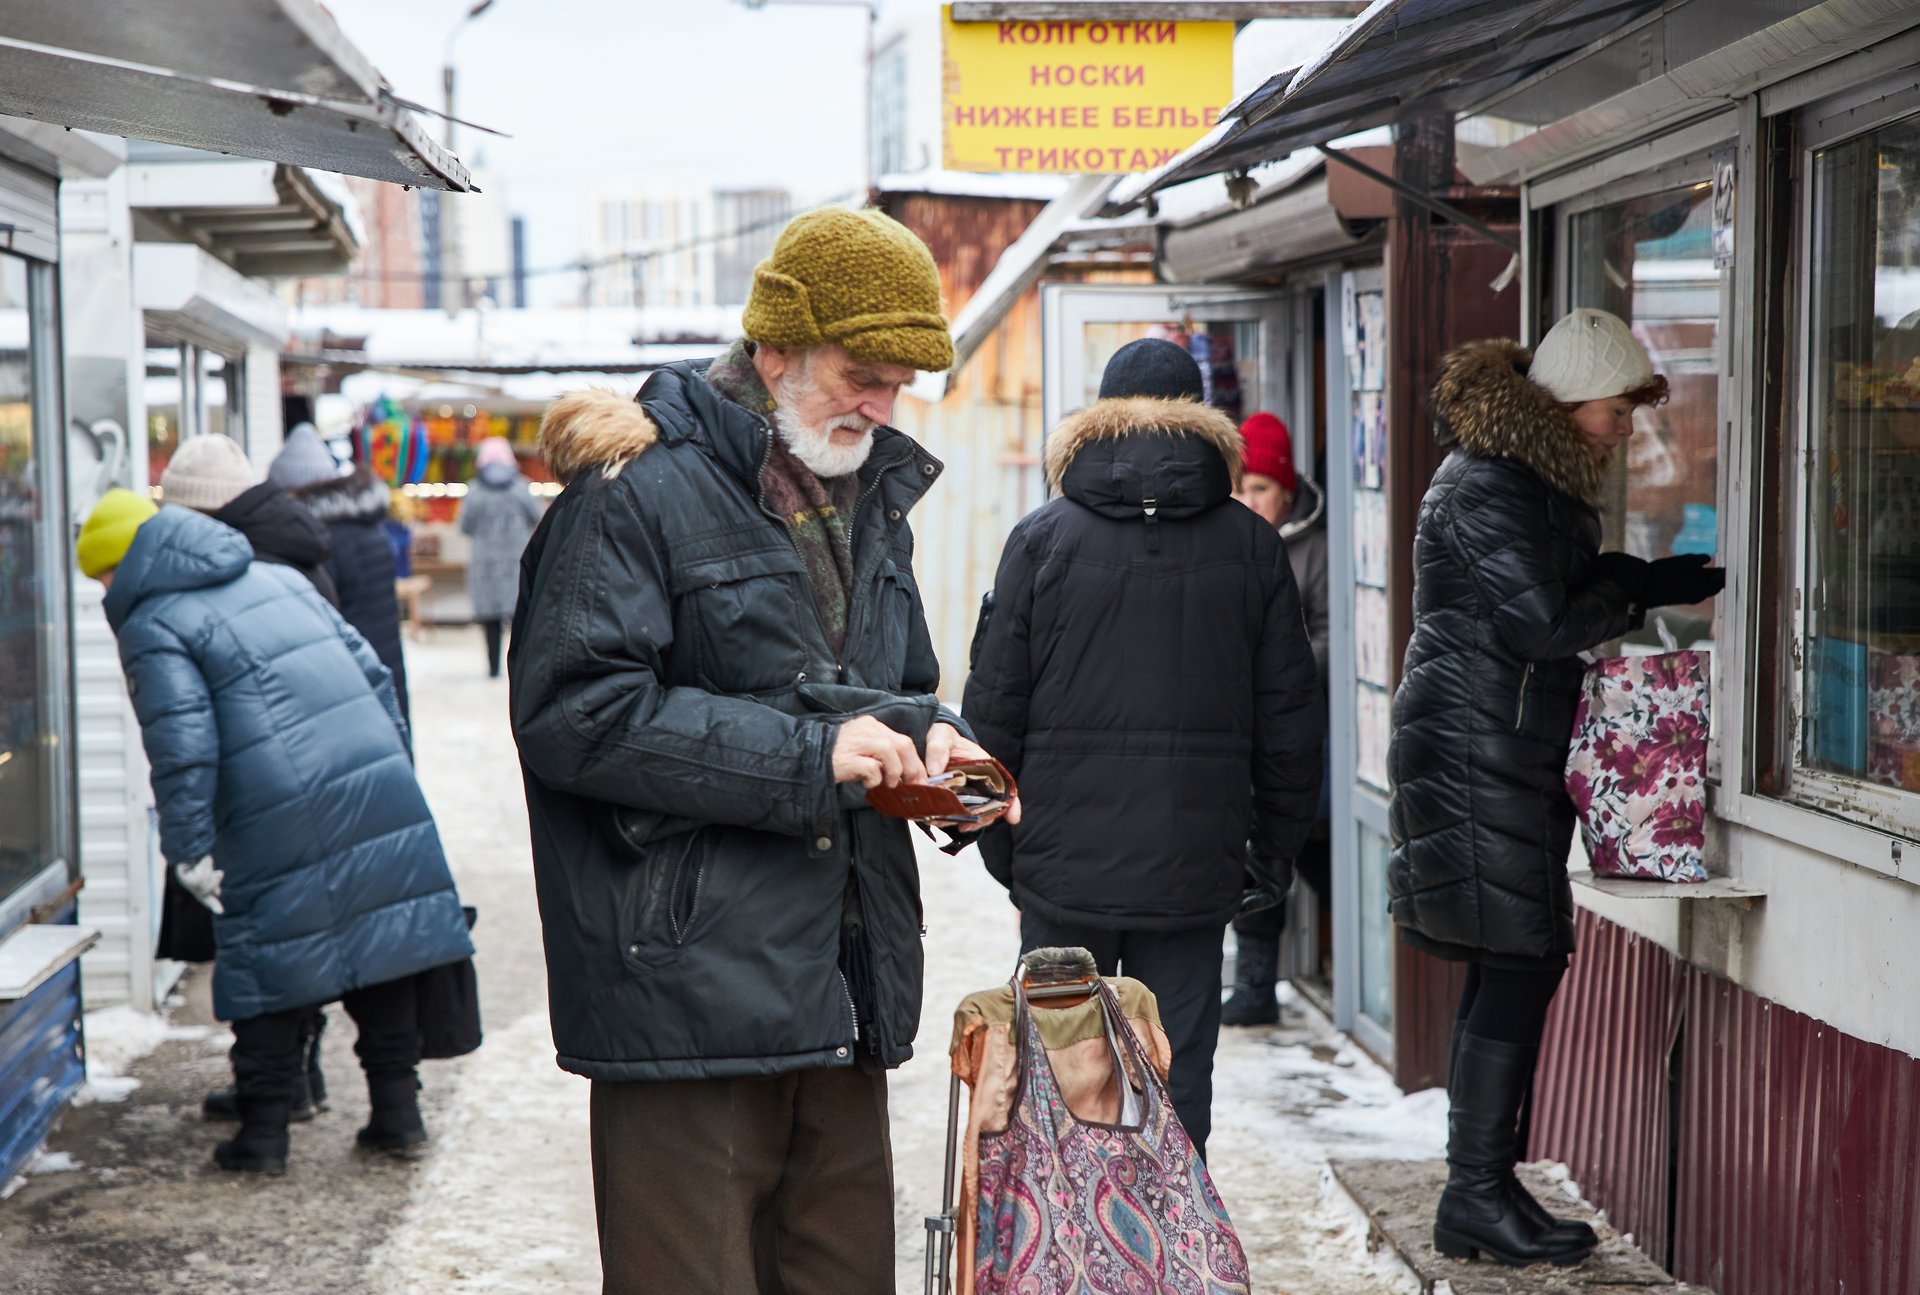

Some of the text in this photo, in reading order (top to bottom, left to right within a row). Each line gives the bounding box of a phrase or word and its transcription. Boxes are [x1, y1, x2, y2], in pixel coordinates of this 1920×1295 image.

[998, 21, 1176, 44] КОЛГОТКИ
[1030, 65, 1144, 86] НОСКИ
[955, 106, 1220, 128] НИЖНЕЕ БЕЛЬЕ
[995, 148, 1180, 170] ТРИКОТАЖ
